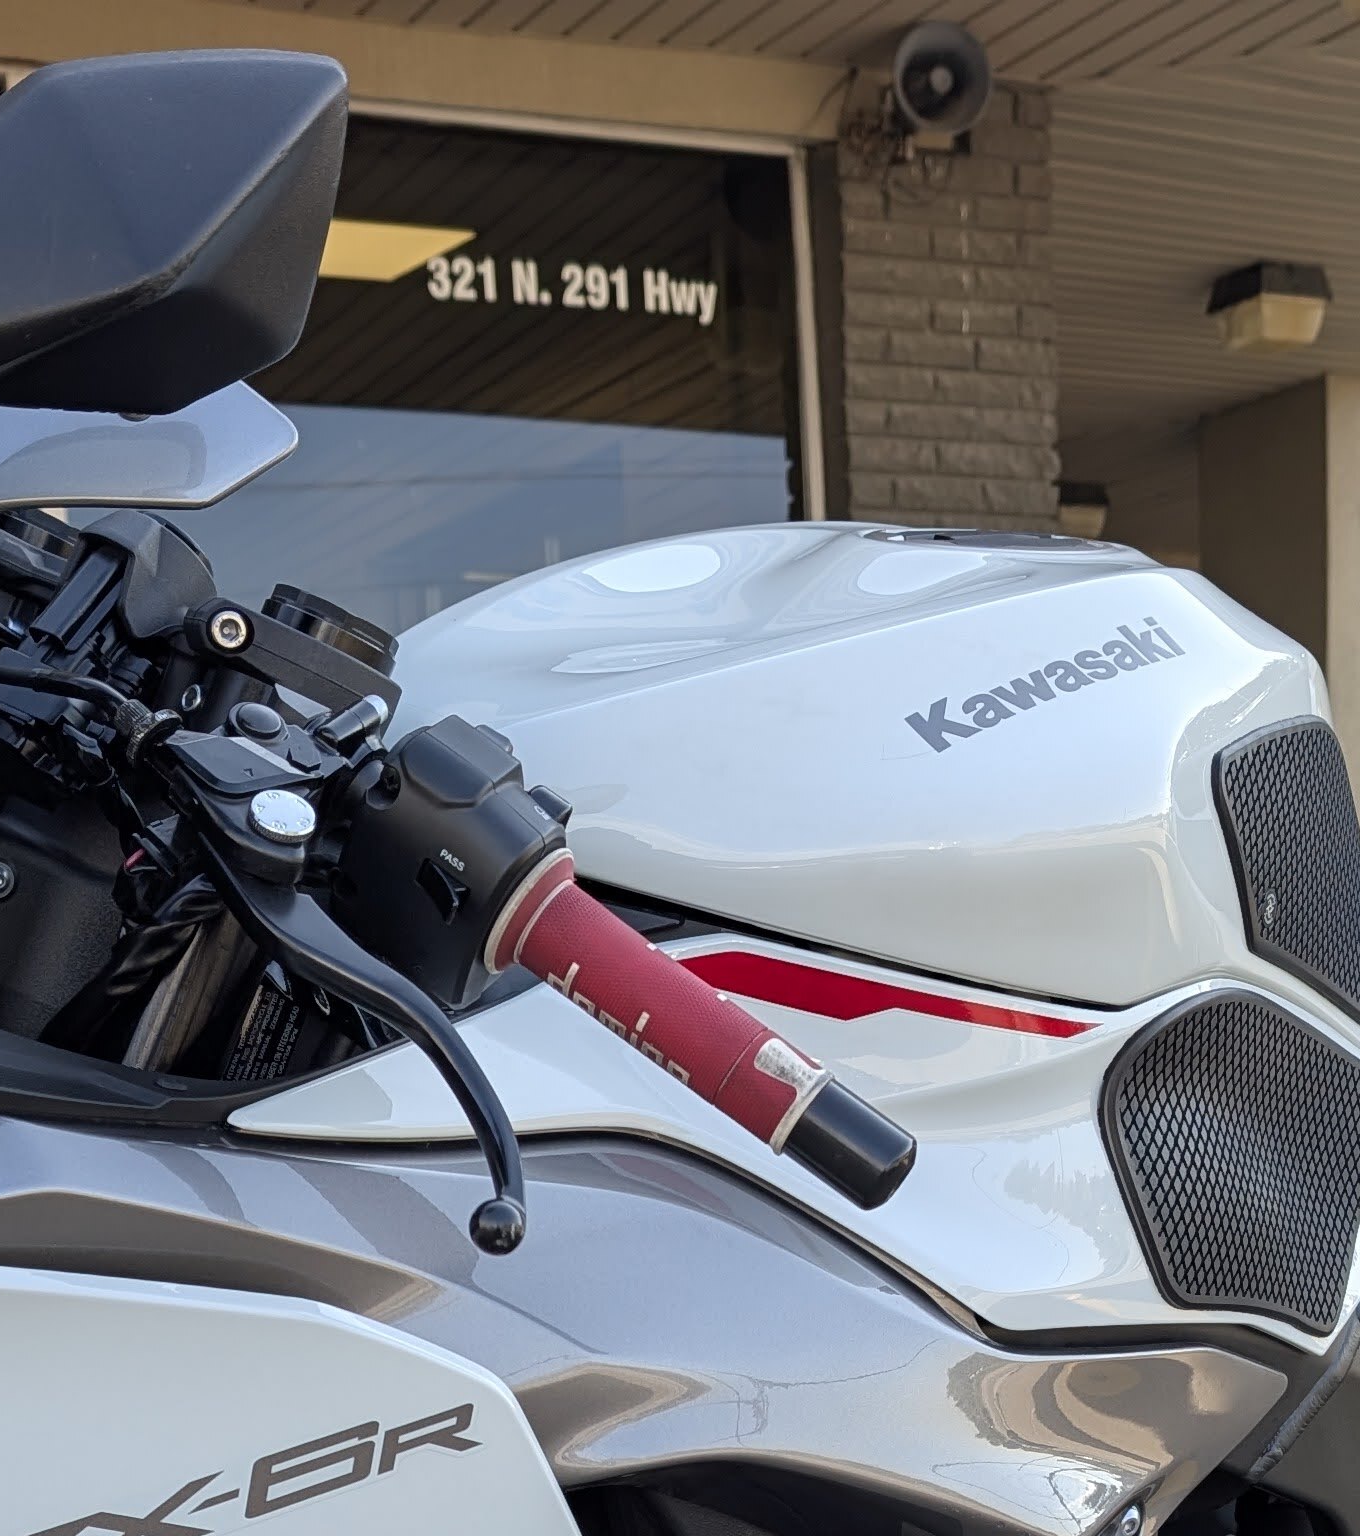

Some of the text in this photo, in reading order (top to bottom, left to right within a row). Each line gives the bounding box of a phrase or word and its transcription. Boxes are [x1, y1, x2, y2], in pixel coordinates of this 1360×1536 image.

[426, 255, 718, 327] 321 N. 291 Hwy
[904, 616, 1186, 754] Kawasaki
[440, 848, 465, 871] PASS
